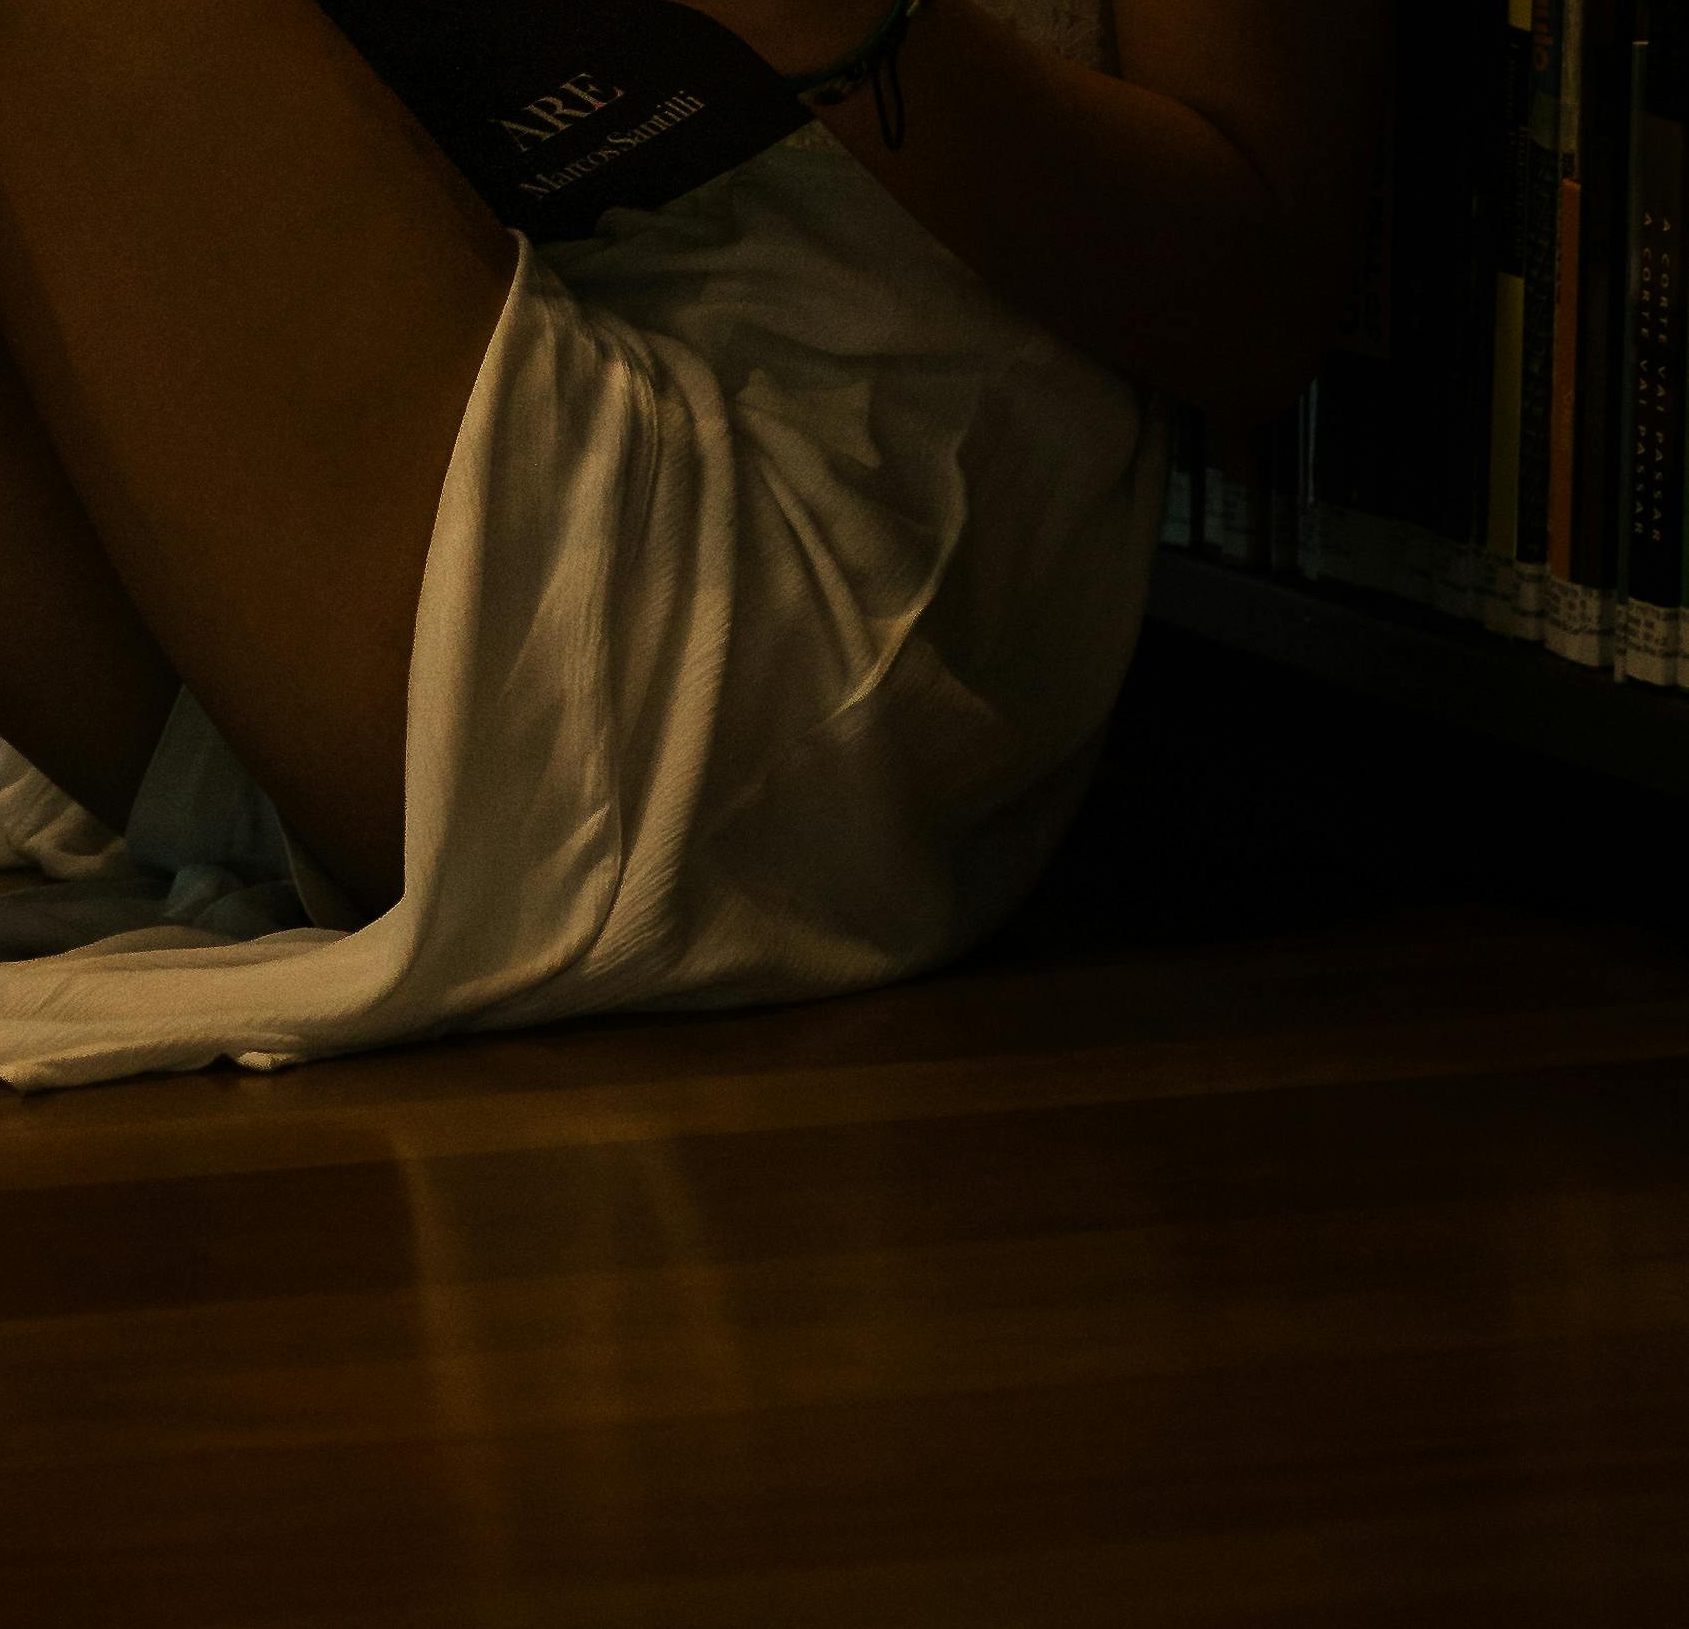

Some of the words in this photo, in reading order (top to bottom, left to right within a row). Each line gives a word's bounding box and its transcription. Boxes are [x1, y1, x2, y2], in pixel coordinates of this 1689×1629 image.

[487, 73, 627, 152] ARE
[518, 146, 620, 199] Marcos
[607, 90, 707, 147] Santilli
[1643, 213, 1653, 226] A
[1661, 218, 1672, 231] A
[1640, 247, 1652, 339] CORTE
[1658, 254, 1670, 343] CORTE
[1638, 360, 1649, 405] VAI
[1655, 366, 1667, 411] VAI
[1633, 425, 1648, 534] PASSAR
[1651, 431, 1665, 541] PASSAR
